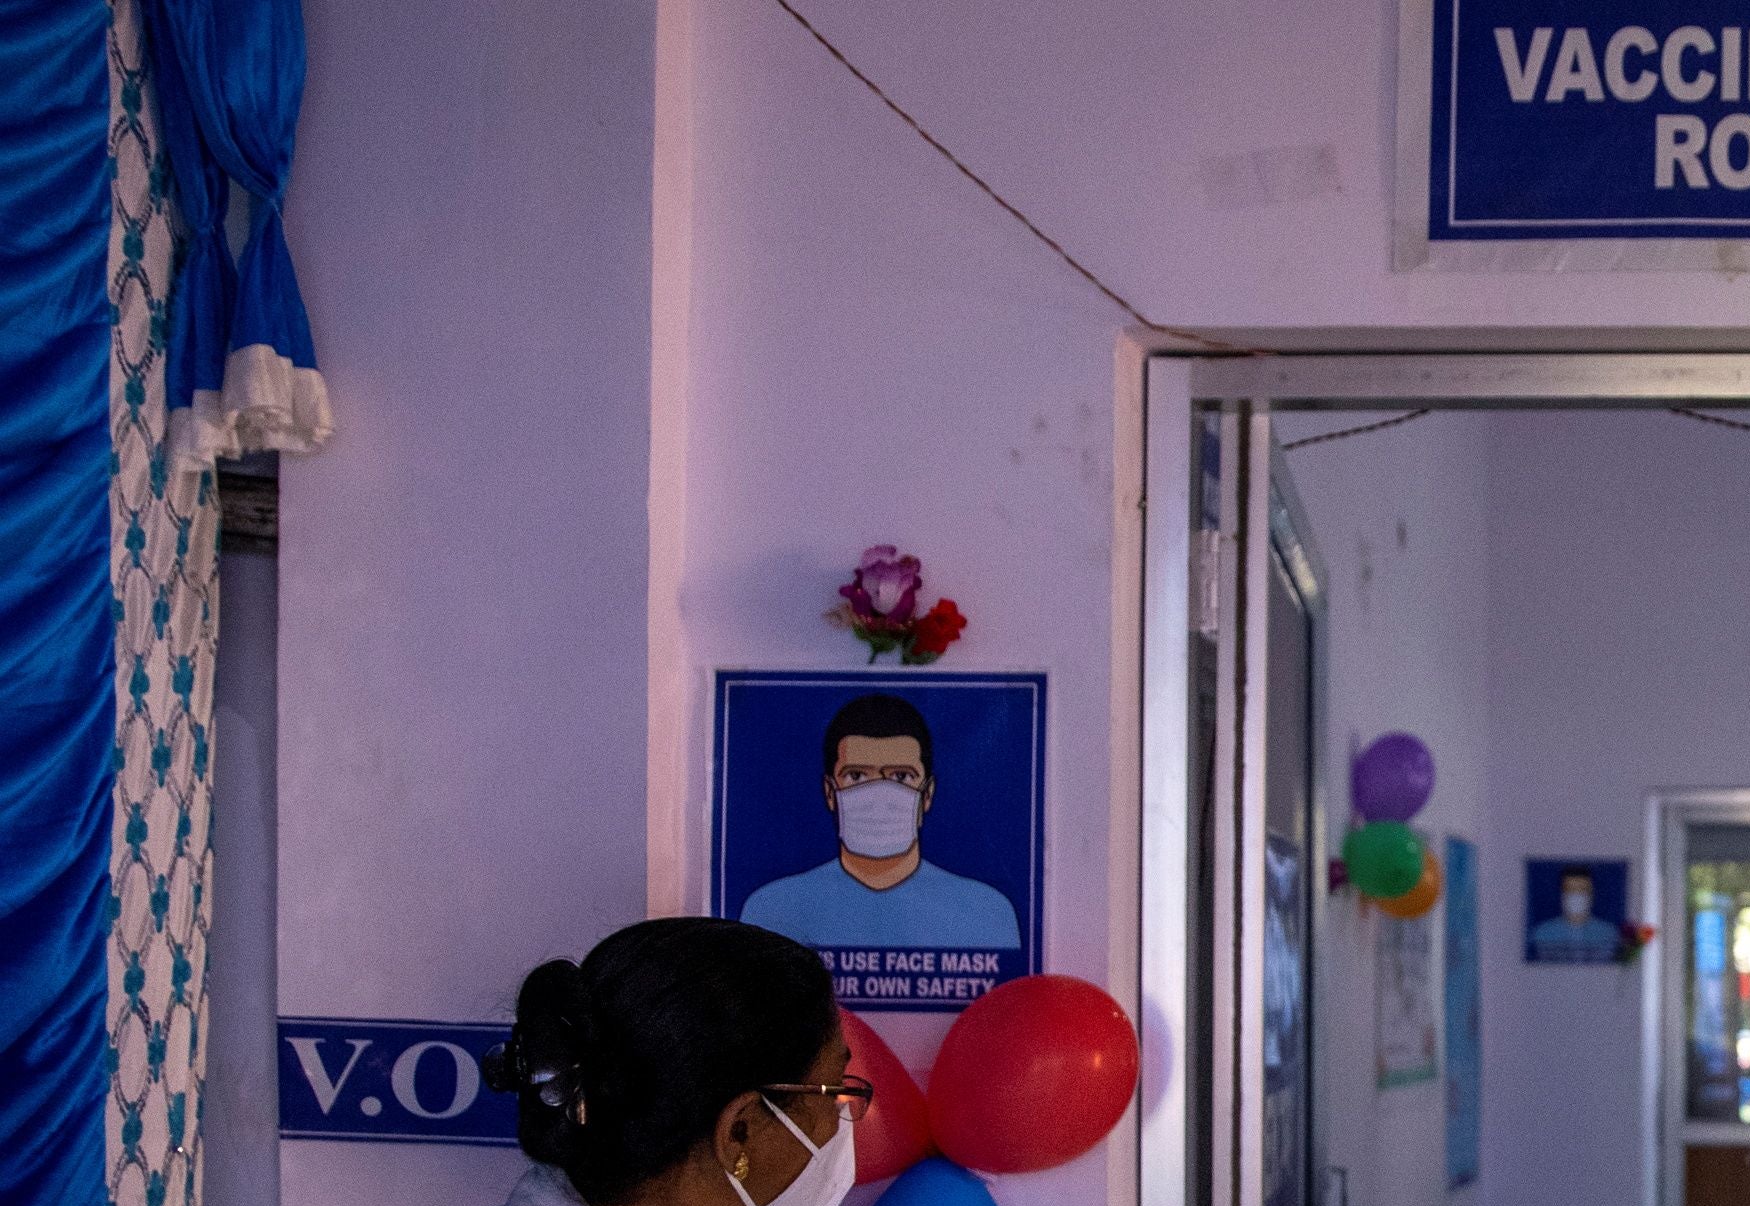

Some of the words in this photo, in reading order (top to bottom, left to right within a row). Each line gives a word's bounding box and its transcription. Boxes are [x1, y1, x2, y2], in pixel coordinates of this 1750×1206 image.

[840, 951, 880, 972] USE
[886, 952, 935, 973] FACE
[941, 953, 999, 974] MASK
[833, 977, 859, 996] UR
[865, 978, 911, 997] OWN
[916, 978, 996, 998] SAFETY
